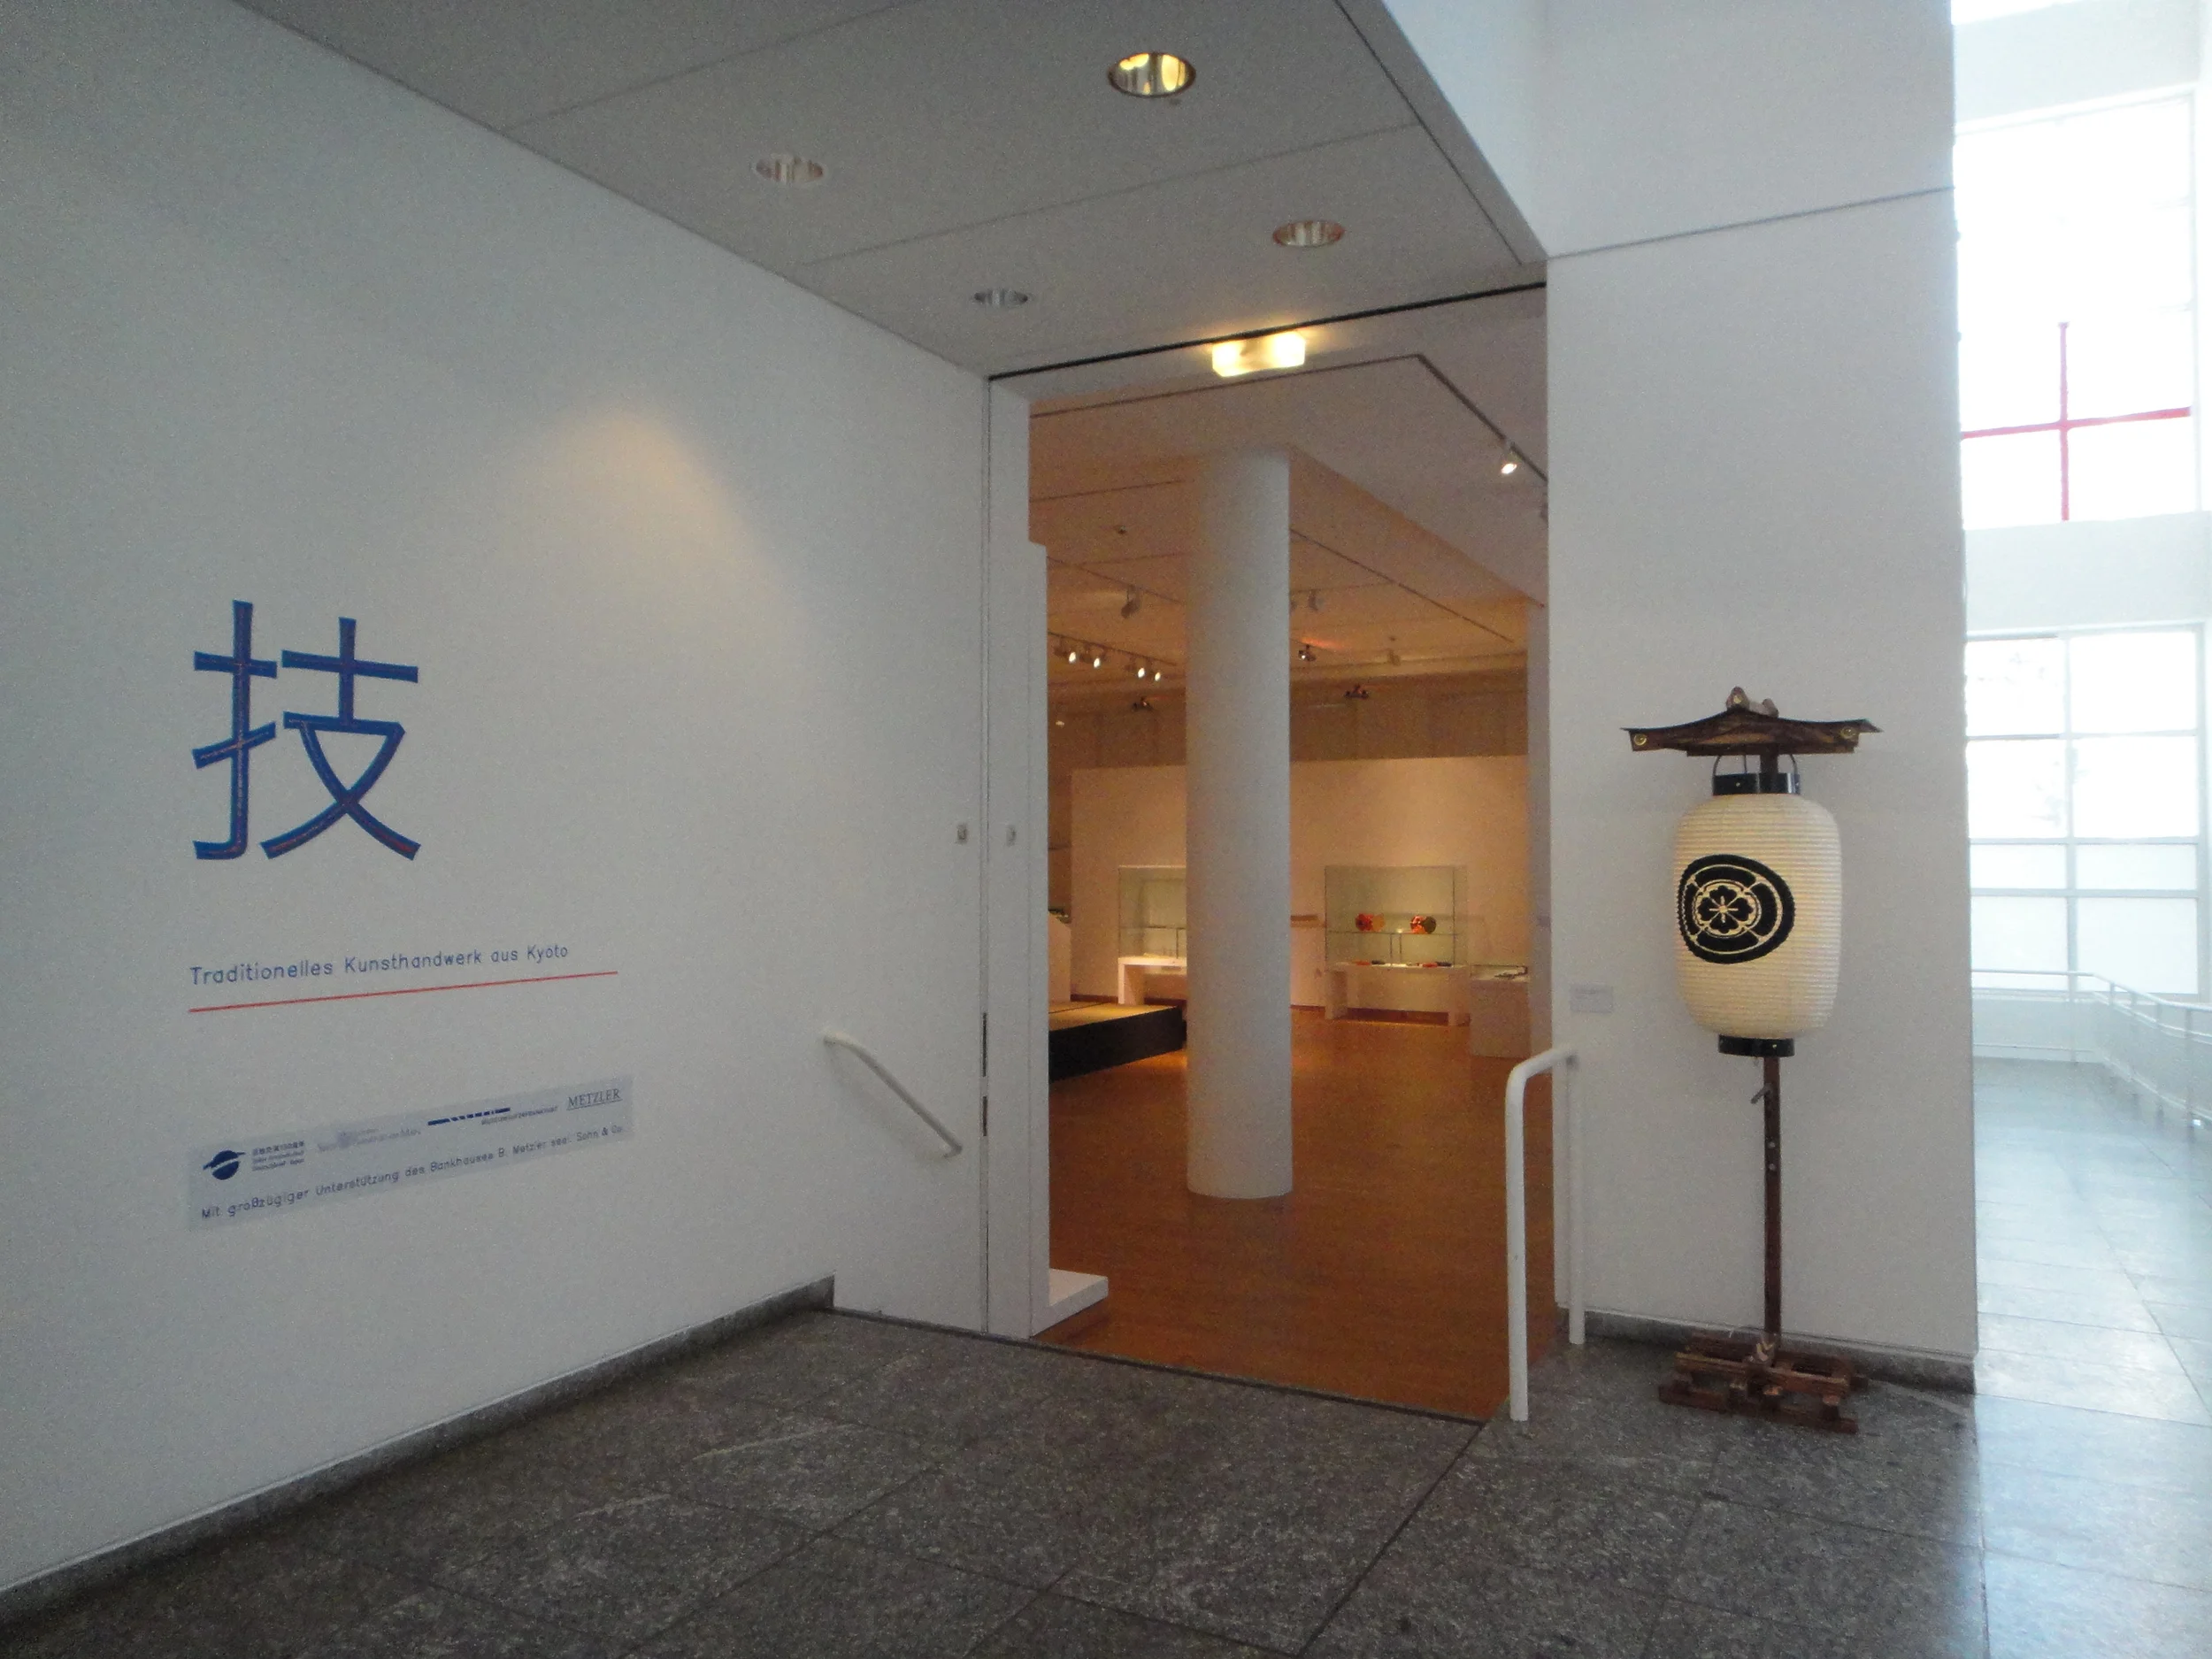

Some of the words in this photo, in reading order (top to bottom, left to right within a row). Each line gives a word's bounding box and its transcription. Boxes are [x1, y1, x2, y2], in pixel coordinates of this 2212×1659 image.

[192, 599, 421, 861] 技
[190, 959, 334, 985] Traditionelles
[344, 949, 482, 973] Kunsthandwerk
[490, 949, 518, 963] aus
[526, 944, 569, 964] Kyoto
[567, 1088, 620, 1108] METZLER
[202, 1205, 221, 1217] Mit
[315, 1171, 400, 1195] Unterstützung
[404, 1166, 425, 1177] des
[430, 1153, 494, 1172] Bankhauses
[513, 1141, 547, 1154] Metzler
[602, 1126, 609, 1136] &
